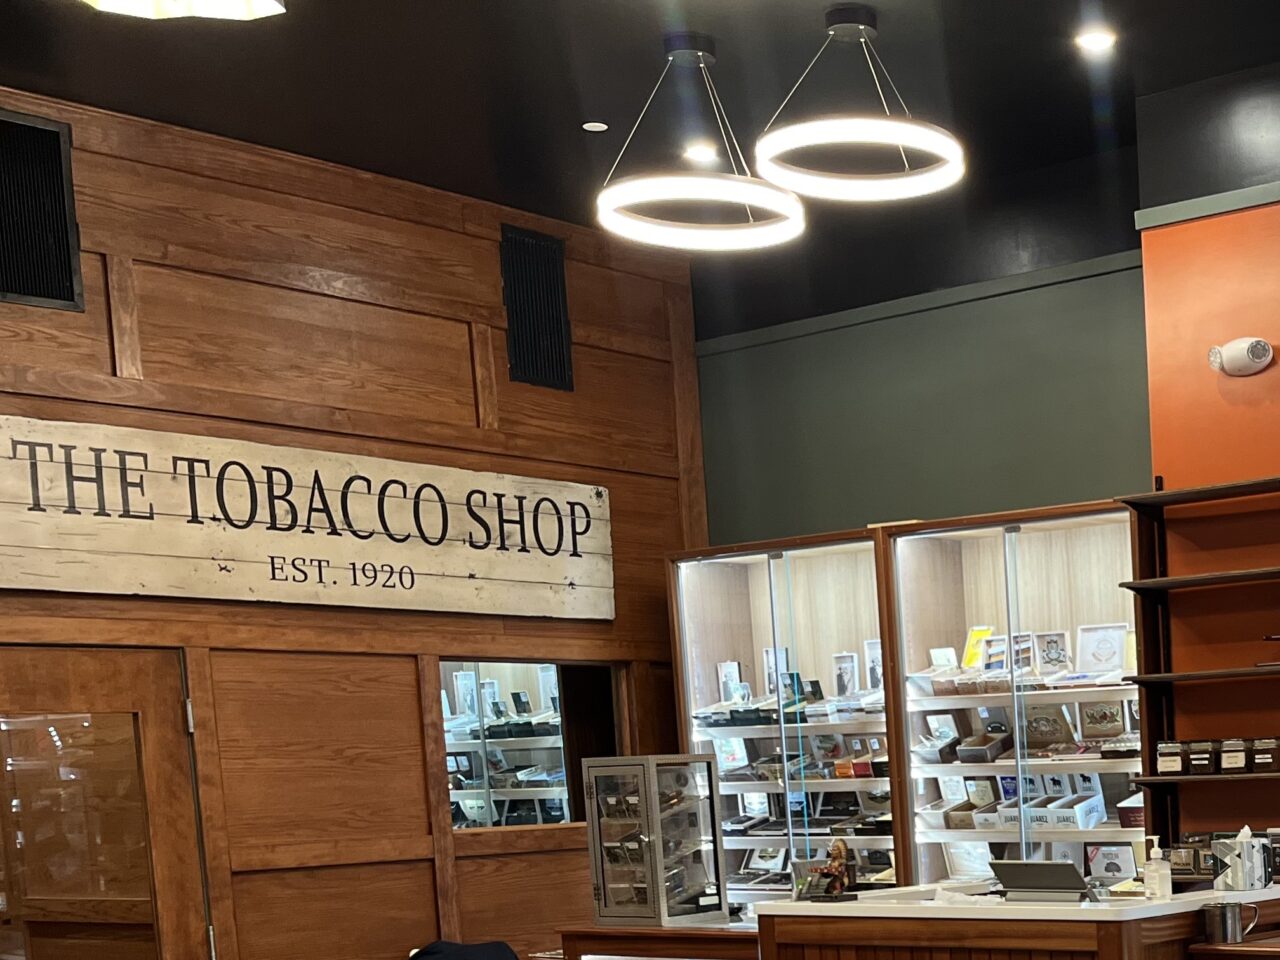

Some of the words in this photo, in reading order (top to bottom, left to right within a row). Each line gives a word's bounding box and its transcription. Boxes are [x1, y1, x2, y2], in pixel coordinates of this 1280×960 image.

[10, 438, 154, 521] THE
[172, 455, 450, 547] TOBACCO
[464, 488, 592, 559] SHOP
[268, 555, 338, 585] EST.
[349, 561, 416, 590] 1920
[1004, 815, 1019, 823] JUARE
[1056, 815, 1076, 824] JUAREZ
